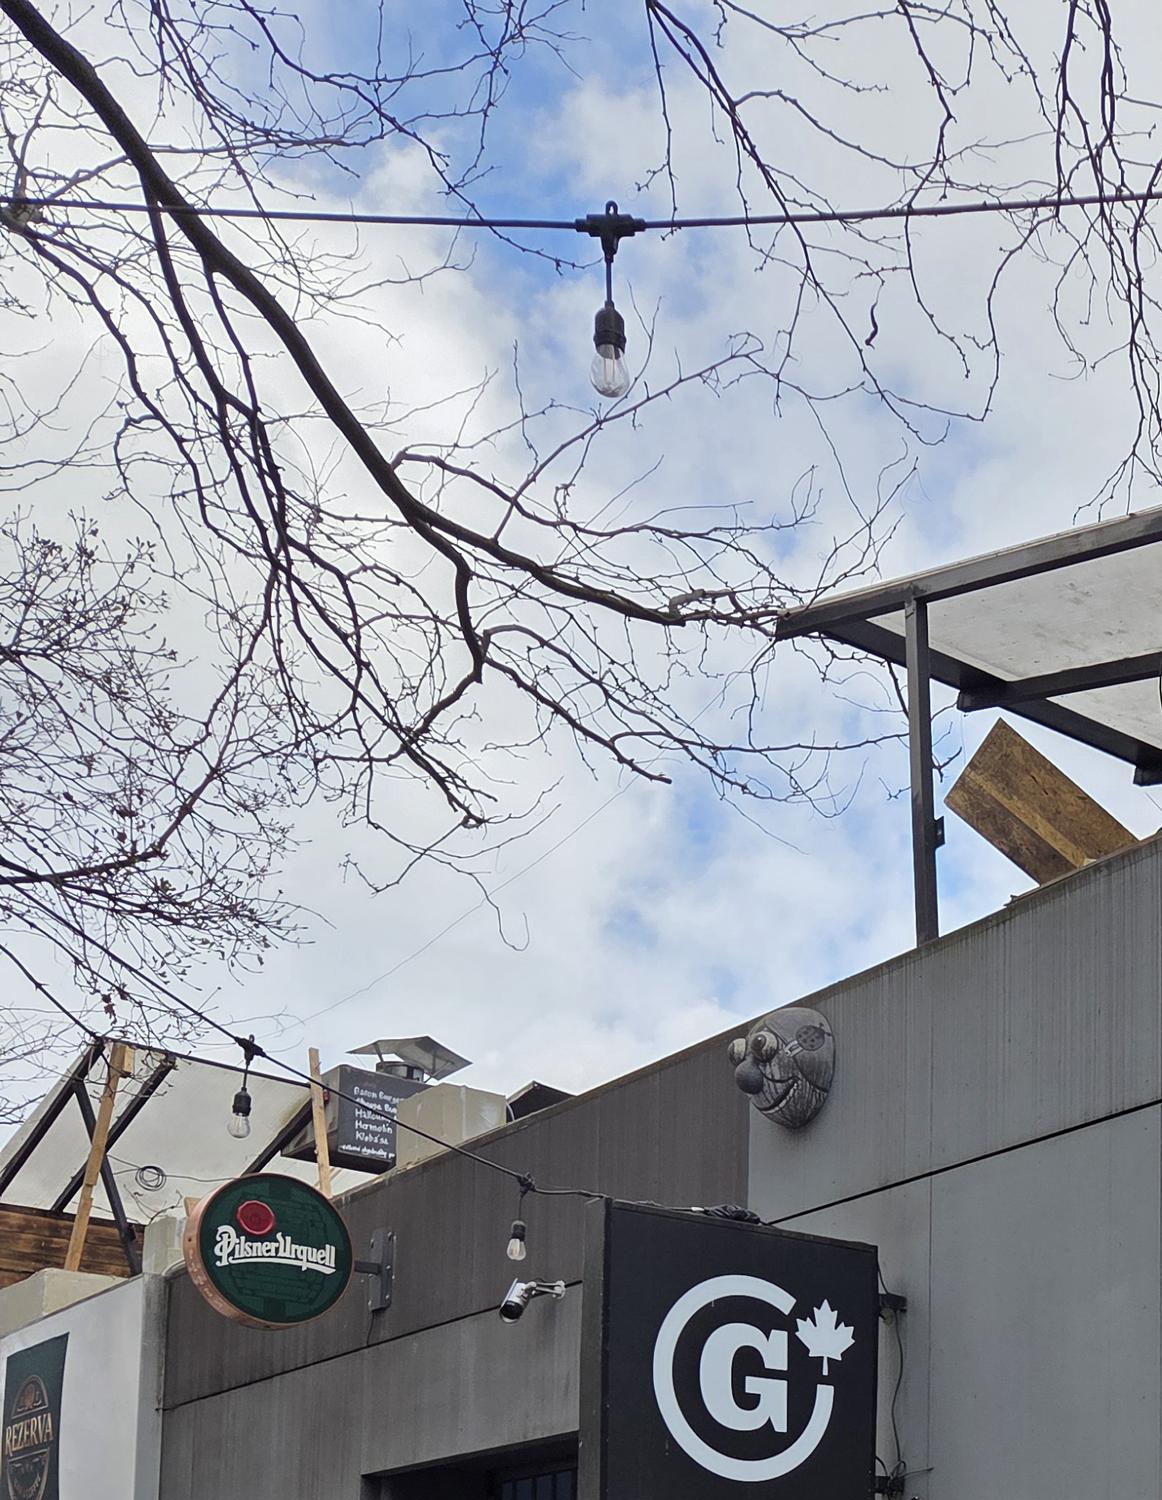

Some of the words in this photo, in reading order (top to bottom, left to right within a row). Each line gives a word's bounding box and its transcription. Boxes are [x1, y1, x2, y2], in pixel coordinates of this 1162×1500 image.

[214, 1225, 280, 1266] Pilsner
[276, 1232, 336, 1272] Urquell
[5, 1412, 54, 1458] REZERVA
